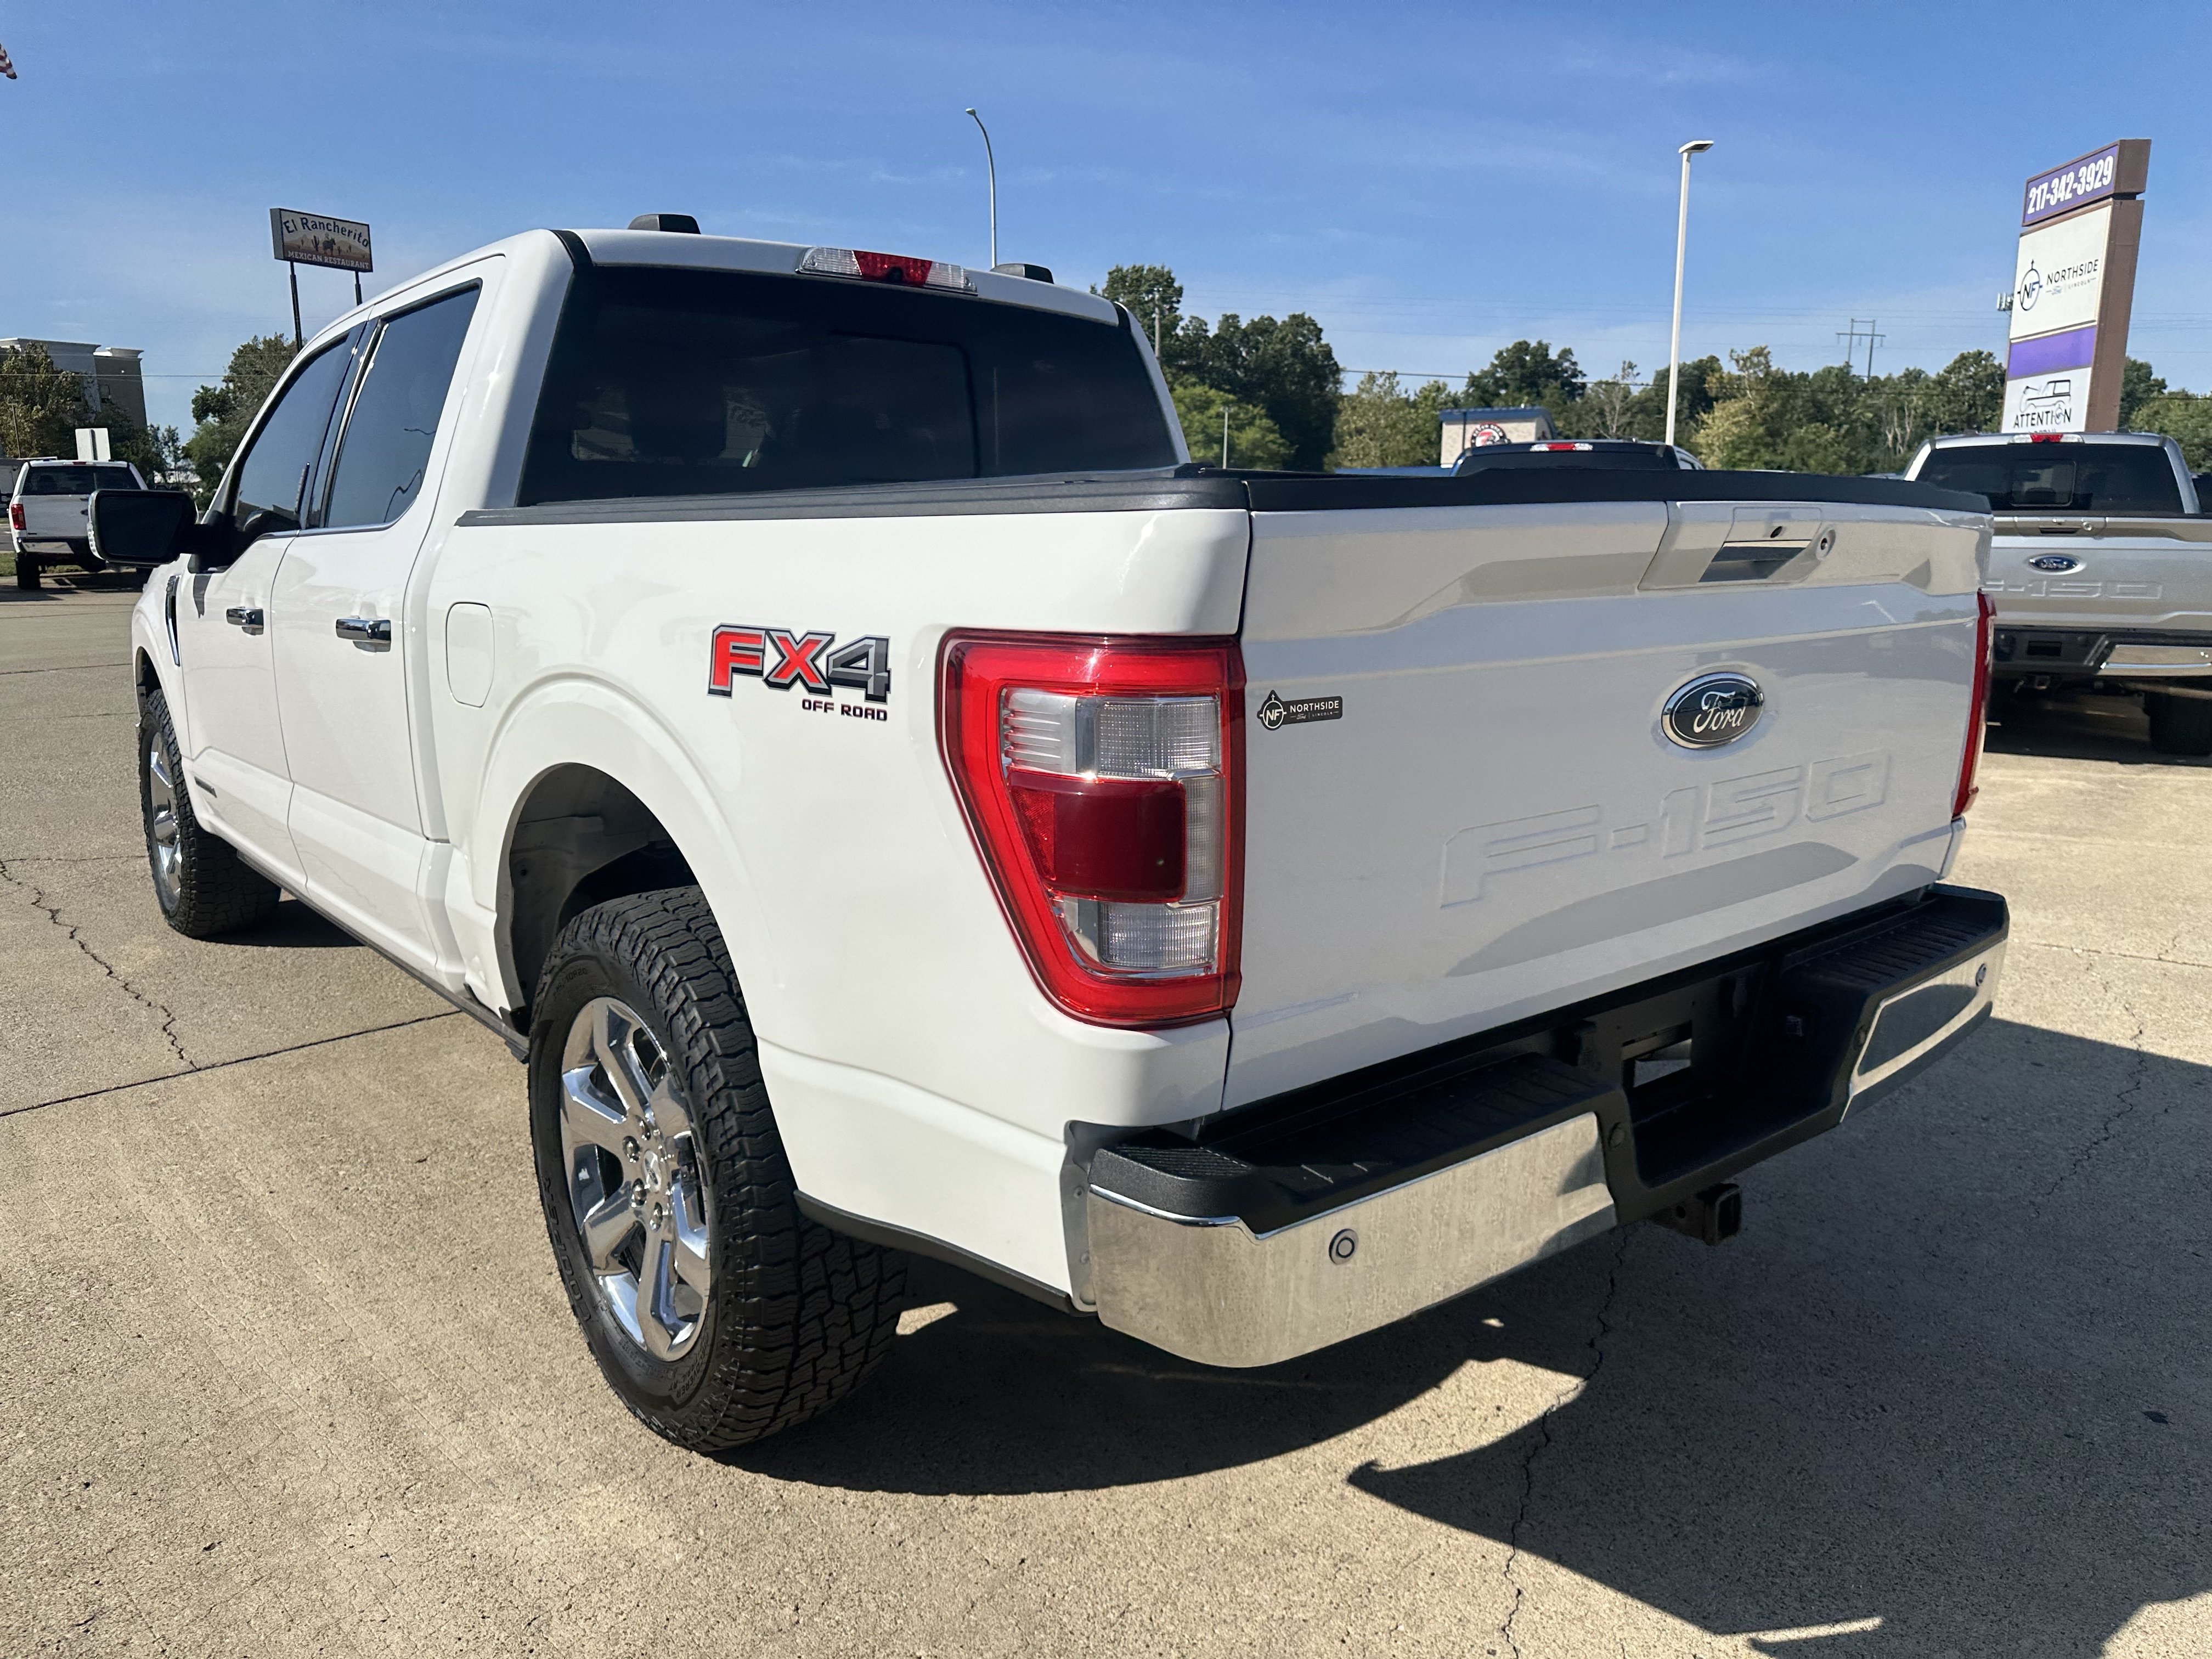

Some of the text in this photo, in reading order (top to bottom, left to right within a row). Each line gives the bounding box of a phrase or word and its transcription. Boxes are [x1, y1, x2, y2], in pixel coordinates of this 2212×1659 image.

[2027, 156, 2113, 214] 217-342-3929
[283, 217, 369, 247] El Rancherito
[288, 251, 369, 269] MEXICAN RESTAURANT
[2046, 259, 2098, 285] NORTHSIDE
[2013, 408, 2072, 428] ATTENTION
[707, 623, 891, 704] FX4
[802, 698, 888, 721] OFF ROAD
[1290, 700, 1339, 713] NORTHSIDE
[1694, 691, 1748, 733] Ford
[1440, 748, 1892, 910] F-150
